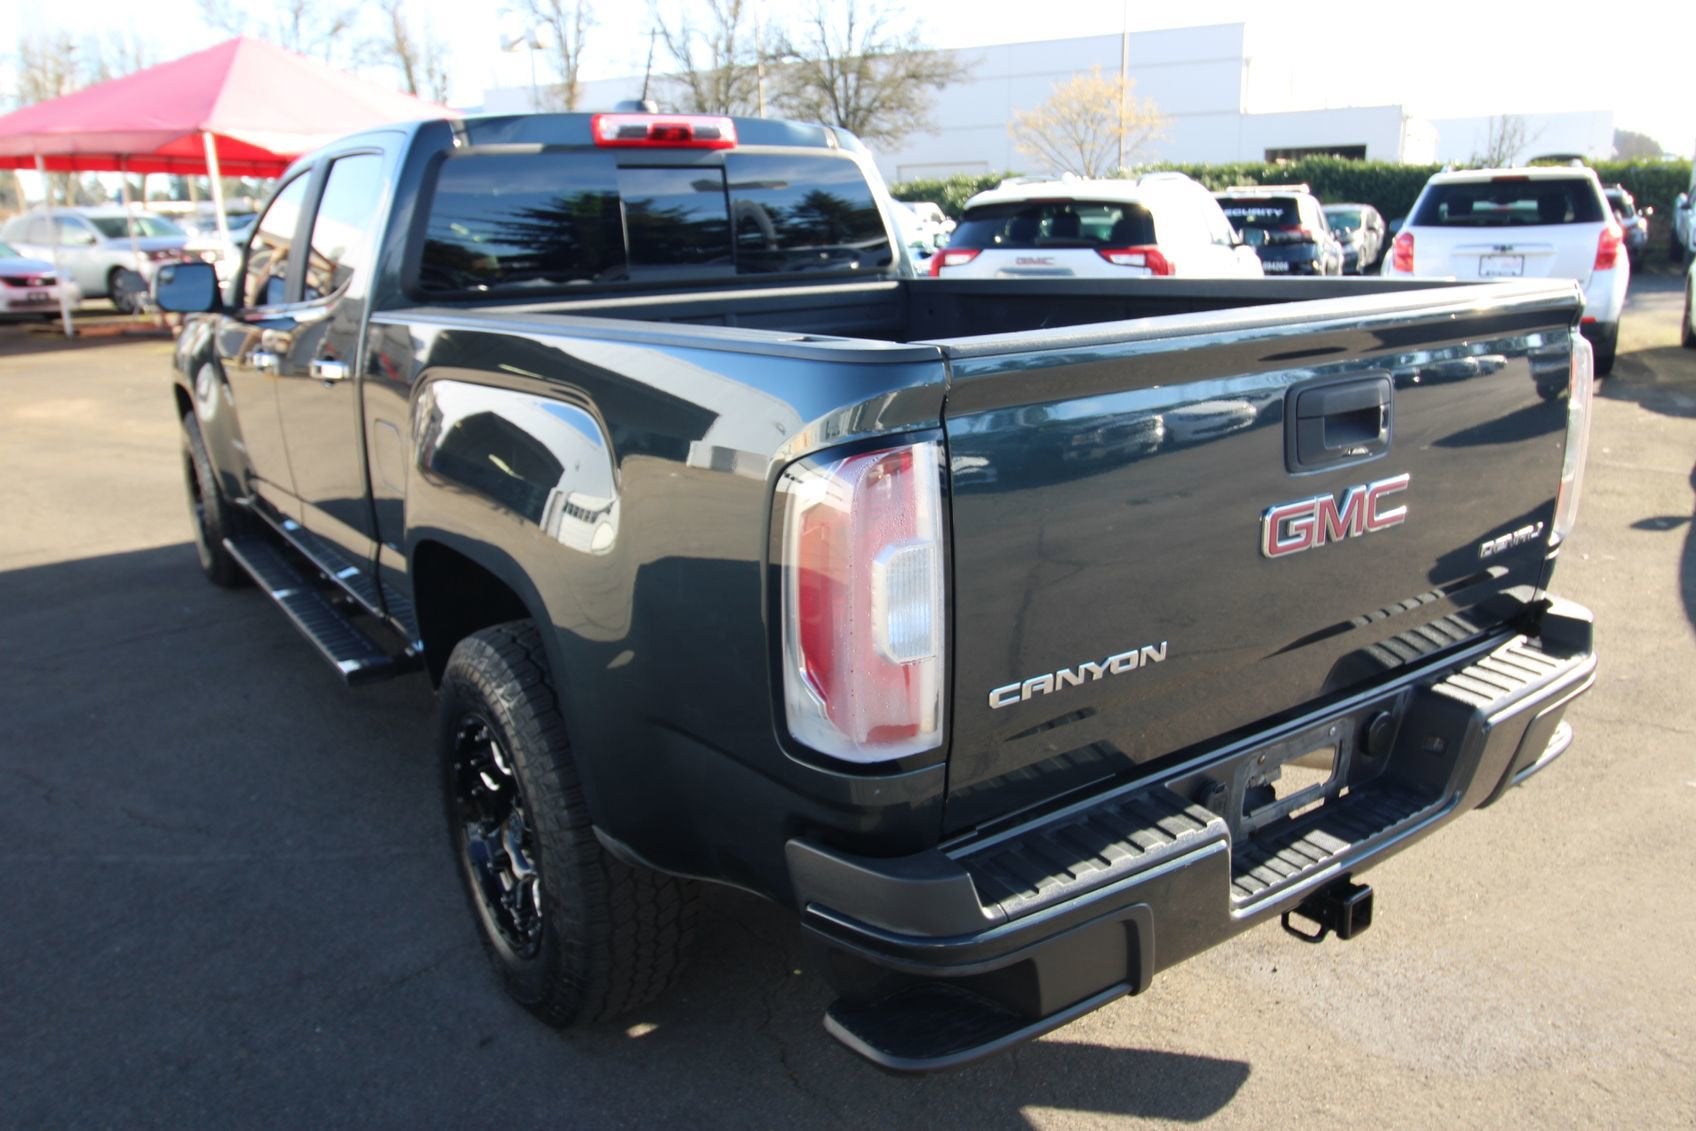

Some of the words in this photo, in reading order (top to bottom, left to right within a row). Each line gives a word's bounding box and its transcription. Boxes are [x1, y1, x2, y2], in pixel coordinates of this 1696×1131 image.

[1222, 208, 1284, 218] ECURITY
[1015, 256, 1055, 266] GMC
[1262, 473, 1410, 559] GMC
[988, 640, 1168, 710] CANYON
